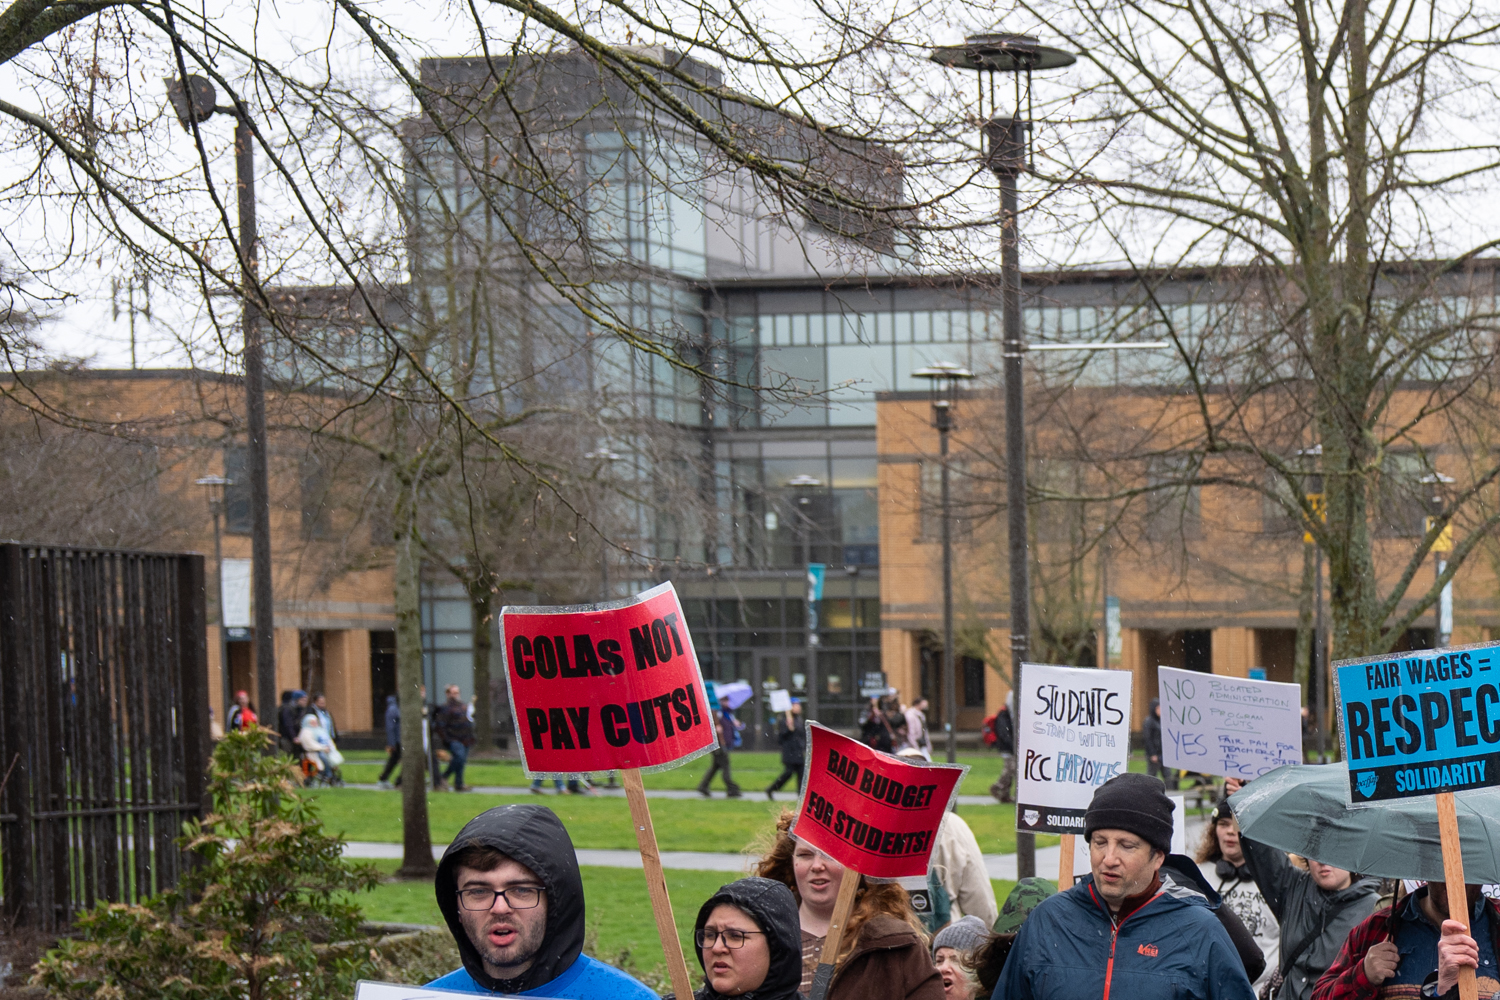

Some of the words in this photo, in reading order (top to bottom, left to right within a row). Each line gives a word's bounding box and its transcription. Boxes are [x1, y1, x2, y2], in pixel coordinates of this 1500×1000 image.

[512, 632, 626, 681] COLAs
[628, 612, 684, 672] NOT
[1365, 662, 1402, 690] FAIR
[1405, 652, 1473, 685] WAGES
[1035, 684, 1124, 727] STUDENTS
[1164, 678, 1196, 701] NO
[1208, 680, 1262, 693] BLOATED
[1209, 692, 1289, 708] ADMINISTRATION
[526, 706, 591, 751] PAY
[600, 683, 701, 749] CUTS!
[1168, 705, 1202, 726] NO
[1210, 708, 1264, 721] PROGRAM
[1224, 718, 1254, 730] CUTS
[1033, 722, 1076, 742] STAND
[1078, 731, 1116, 748] WITH
[1168, 728, 1208, 761] YES
[1218, 734, 1244, 745] FAIR
[1249, 739, 1268, 749] PAY
[826, 748, 859, 785] BAD
[858, 764, 937, 810] BUDGET
[1025, 749, 1051, 782] PCC
[1056, 751, 1121, 786] EMPLOYEES
[1395, 759, 1487, 793] SOLIDARITY
[807, 790, 833, 828] FOR
[832, 807, 934, 855] STUDENTS!
